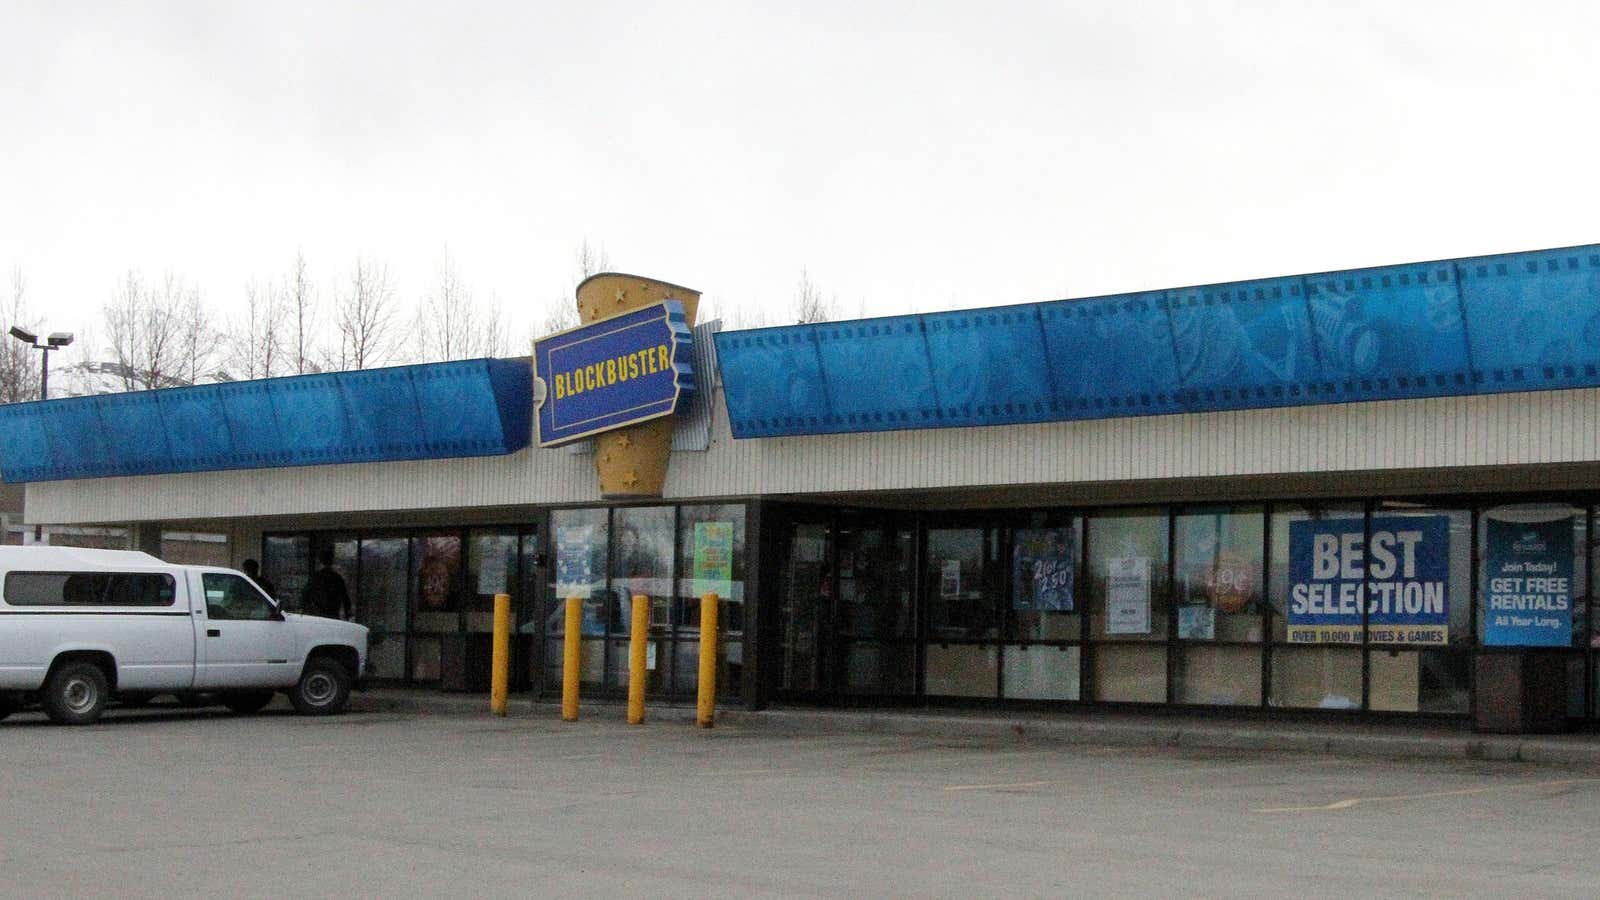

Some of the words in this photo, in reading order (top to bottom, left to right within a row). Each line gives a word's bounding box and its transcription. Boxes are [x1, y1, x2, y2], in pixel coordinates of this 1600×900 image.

[555, 345, 669, 399] BLOCKBUSTER
[1312, 530, 1423, 579] BEST
[1502, 563, 1522, 572] Join
[1524, 562, 1557, 574] Today!
[1491, 578, 1523, 592] GET
[1526, 578, 1568, 592] FREE
[1291, 582, 1444, 614] SELECTION
[1491, 595, 1568, 609] RENTALS
[1496, 616, 1508, 625] All
[1510, 616, 1533, 626] Year
[1292, 631, 1315, 642] OVER
[1397, 631, 1405, 641] &
[1408, 630, 1443, 642] GAMES
